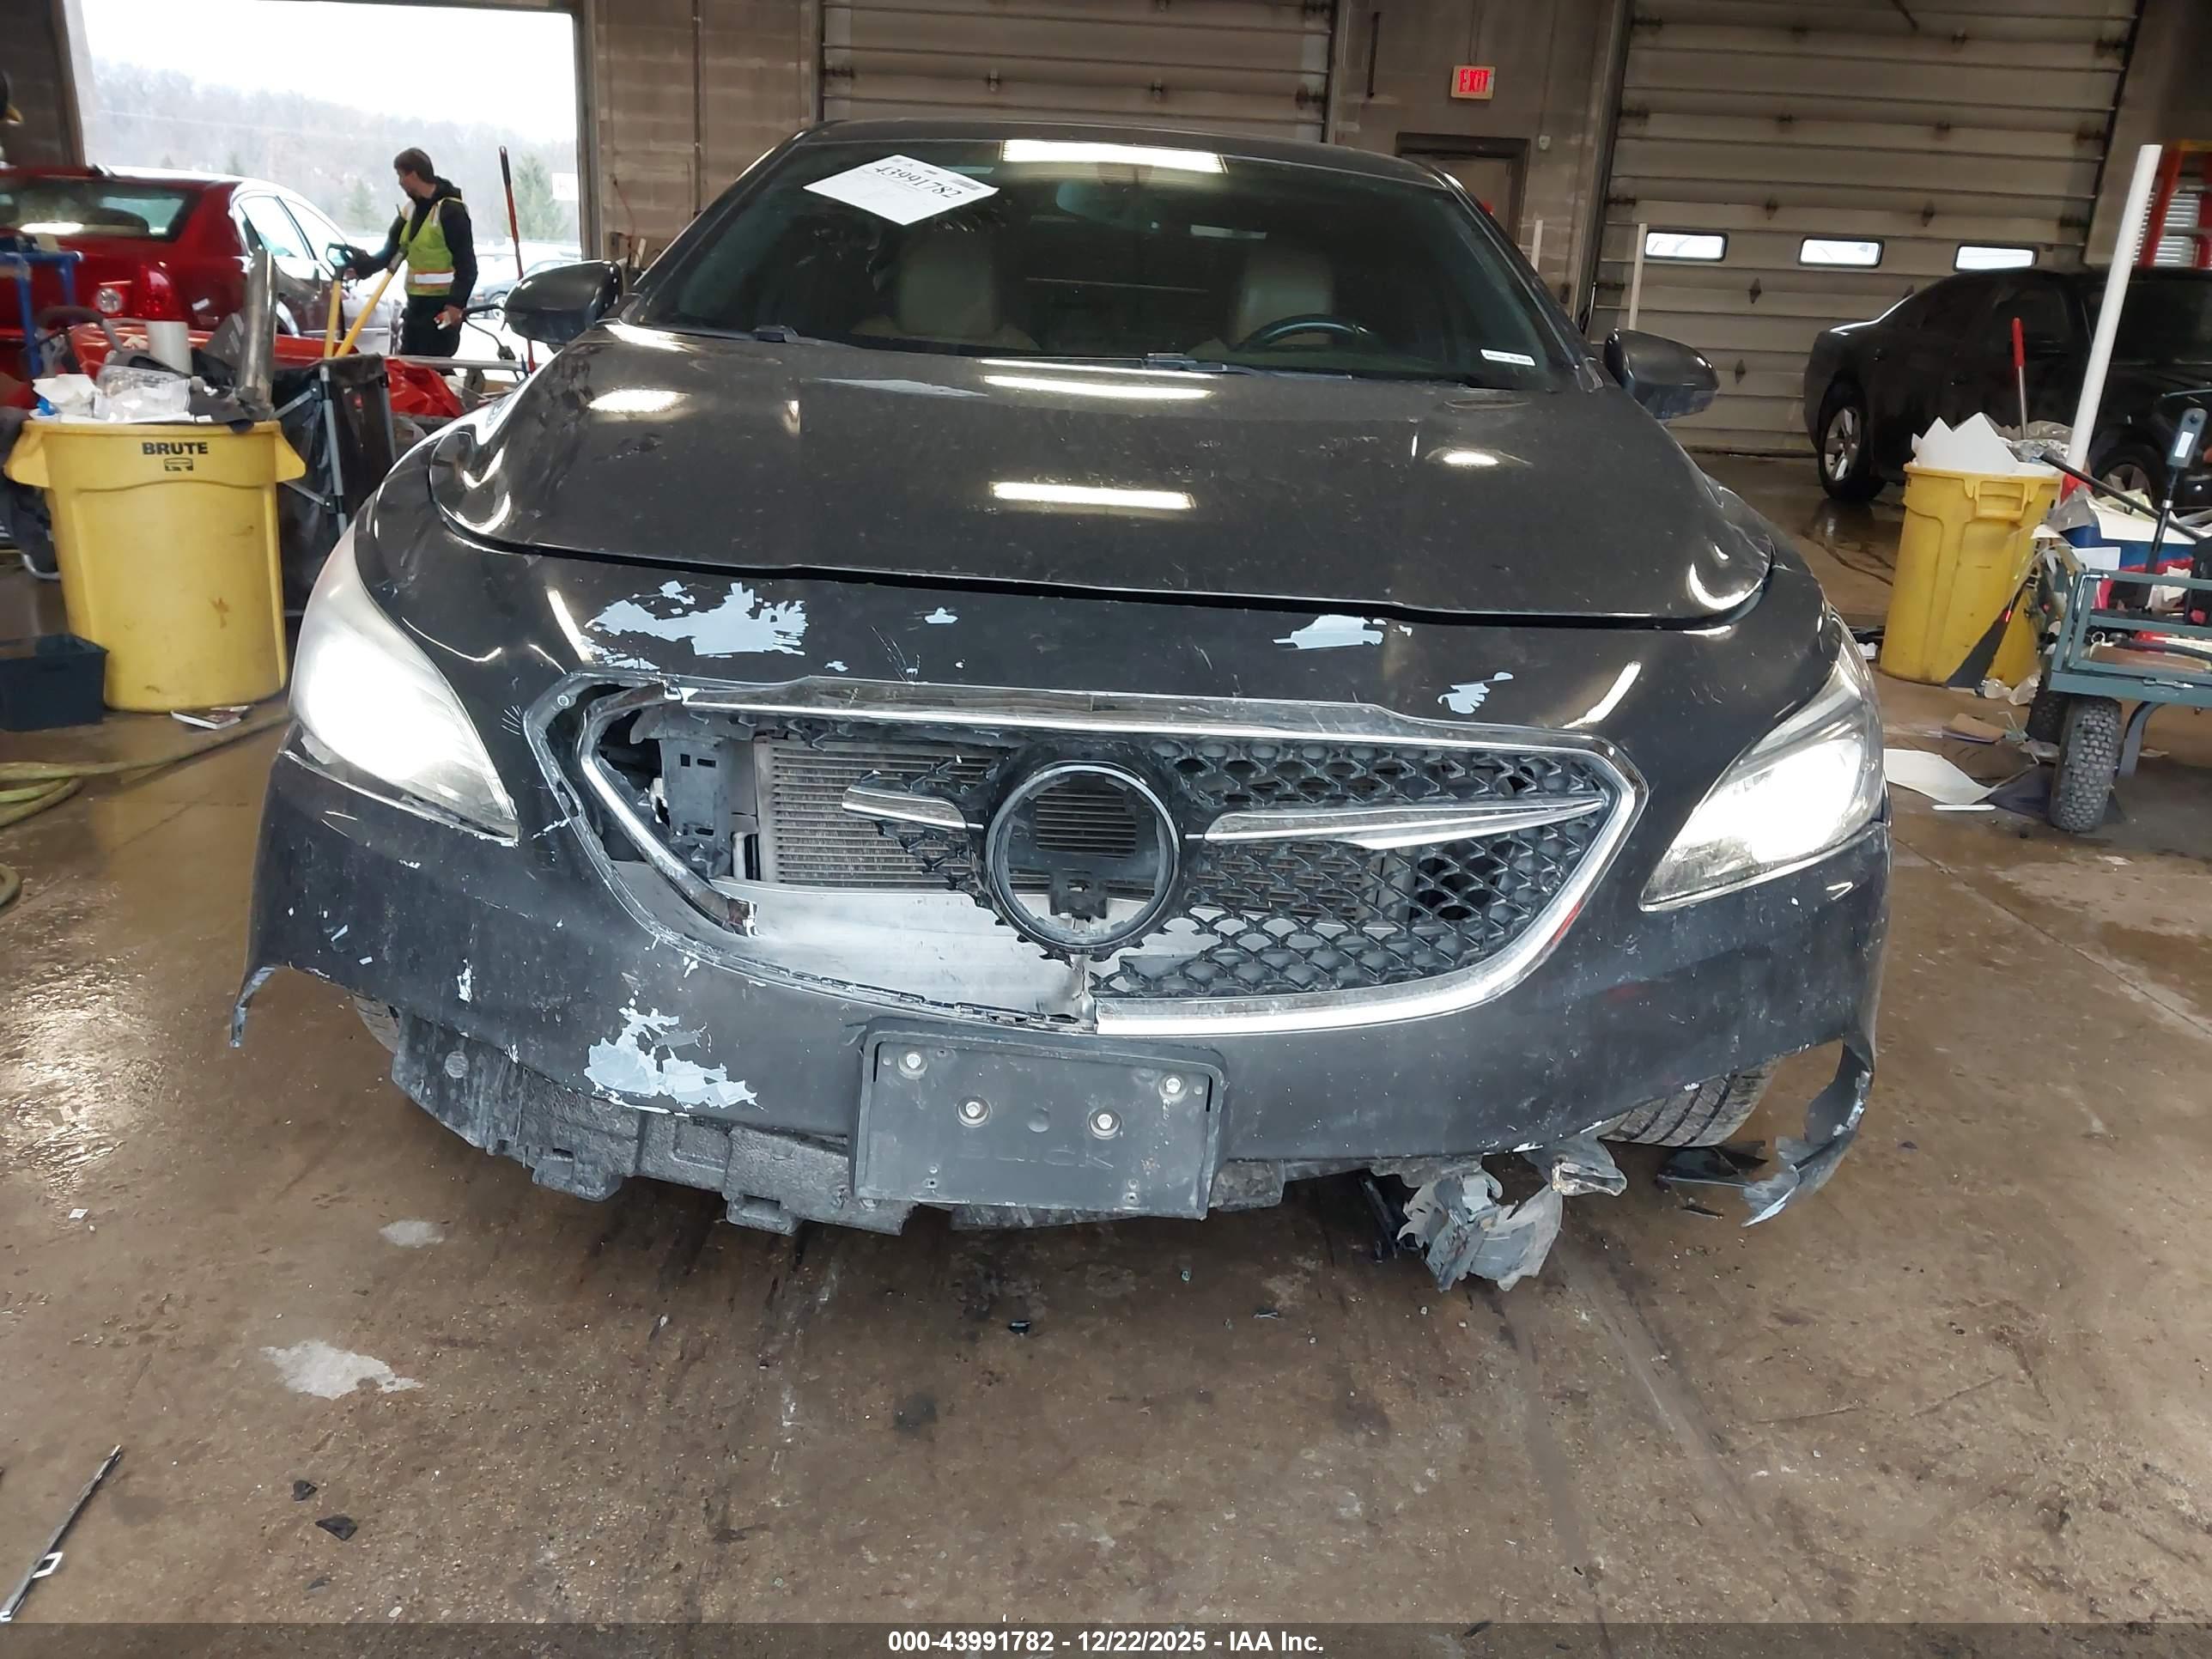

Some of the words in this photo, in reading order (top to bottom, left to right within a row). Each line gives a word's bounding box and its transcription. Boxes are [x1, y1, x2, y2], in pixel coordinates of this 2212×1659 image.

[1459, 69, 1490, 93] EXIT
[874, 166, 963, 198] 43991782
[142, 441, 209, 455] BRUTE
